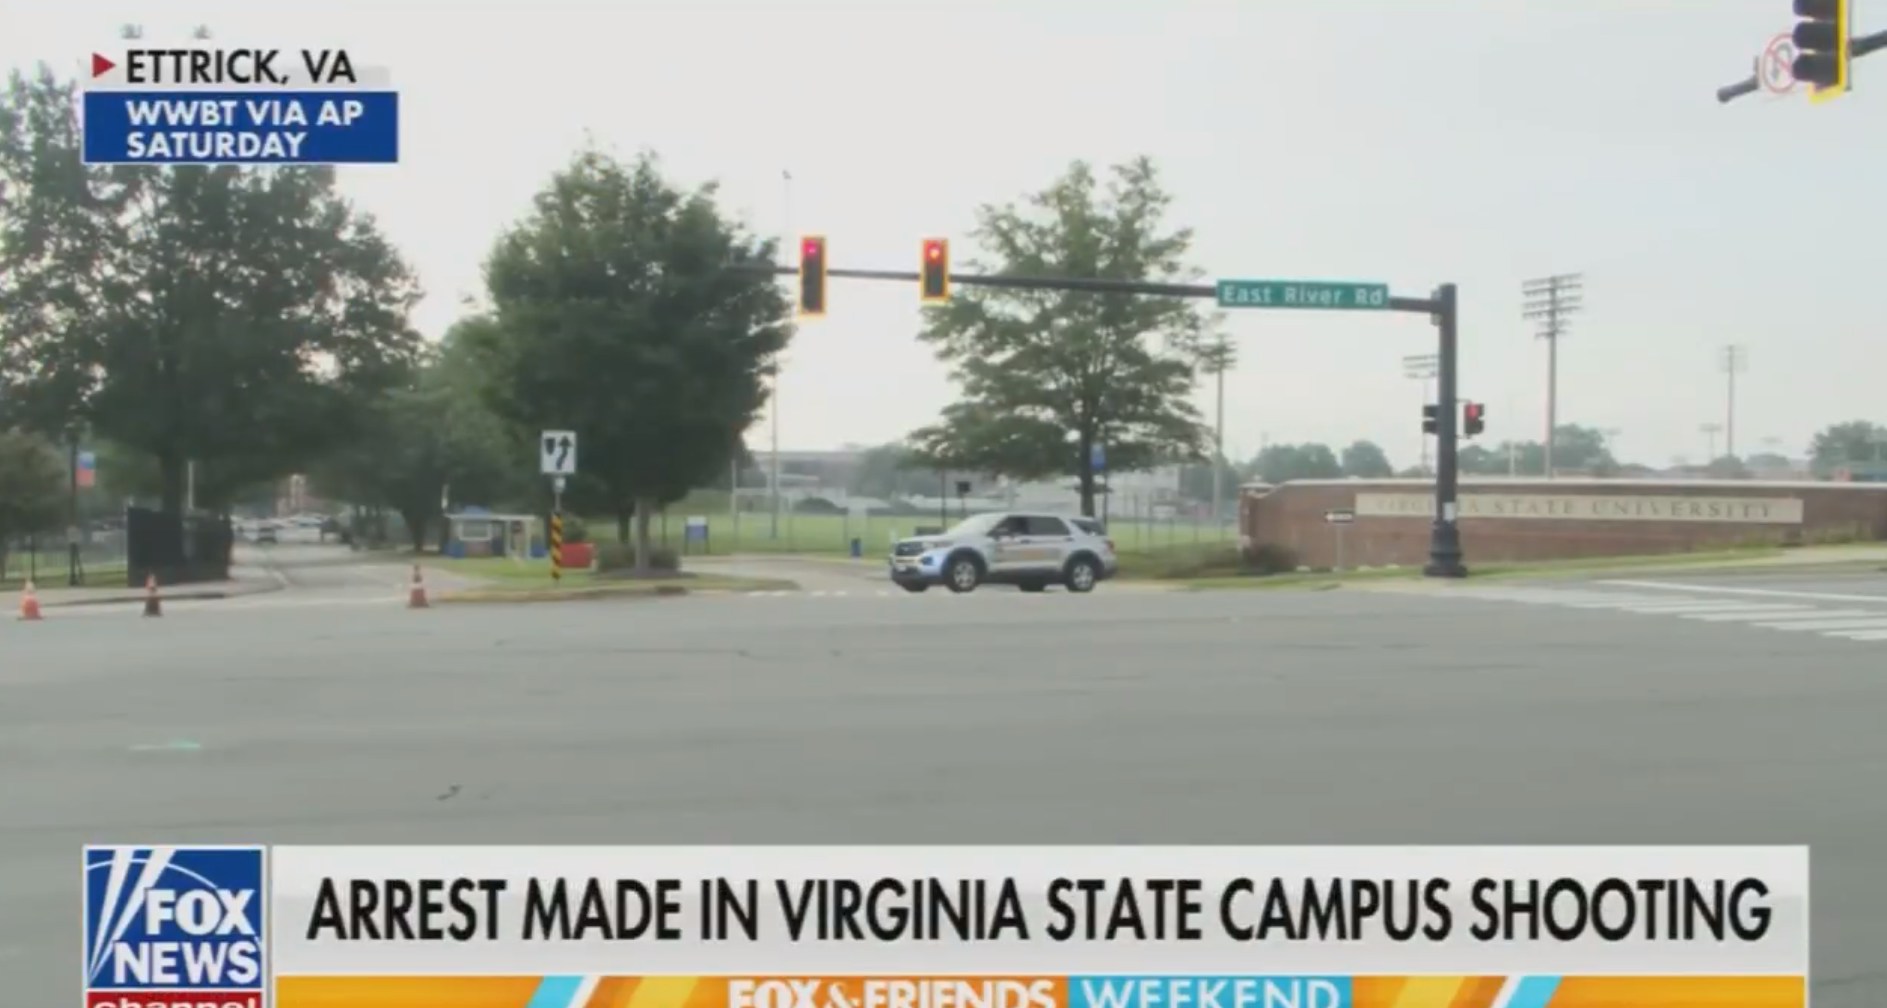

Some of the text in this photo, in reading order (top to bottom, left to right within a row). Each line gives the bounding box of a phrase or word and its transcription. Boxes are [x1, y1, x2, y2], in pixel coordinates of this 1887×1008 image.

[1223, 285, 1384, 305] East River Rd
[1375, 498, 1770, 518] VIRGIIA STATE UNIVERSITY
